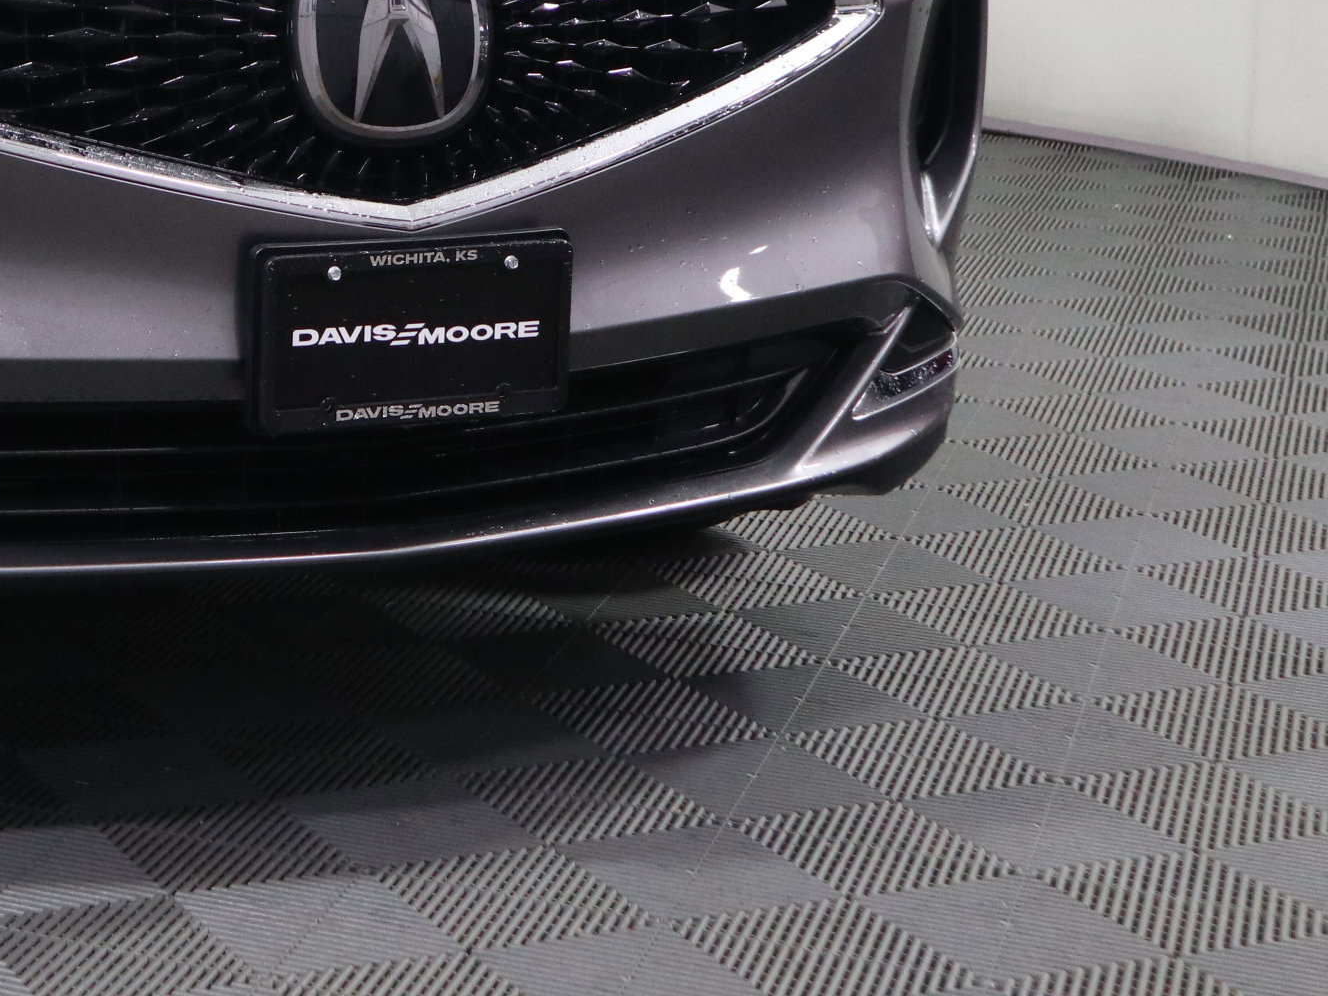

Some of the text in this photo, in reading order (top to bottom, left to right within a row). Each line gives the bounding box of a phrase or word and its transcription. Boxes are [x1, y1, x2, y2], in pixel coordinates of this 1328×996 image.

[455, 249, 478, 262] KS
[292, 320, 540, 347] DAVIS MOORE
[336, 401, 500, 422] DAVIS MOORE
